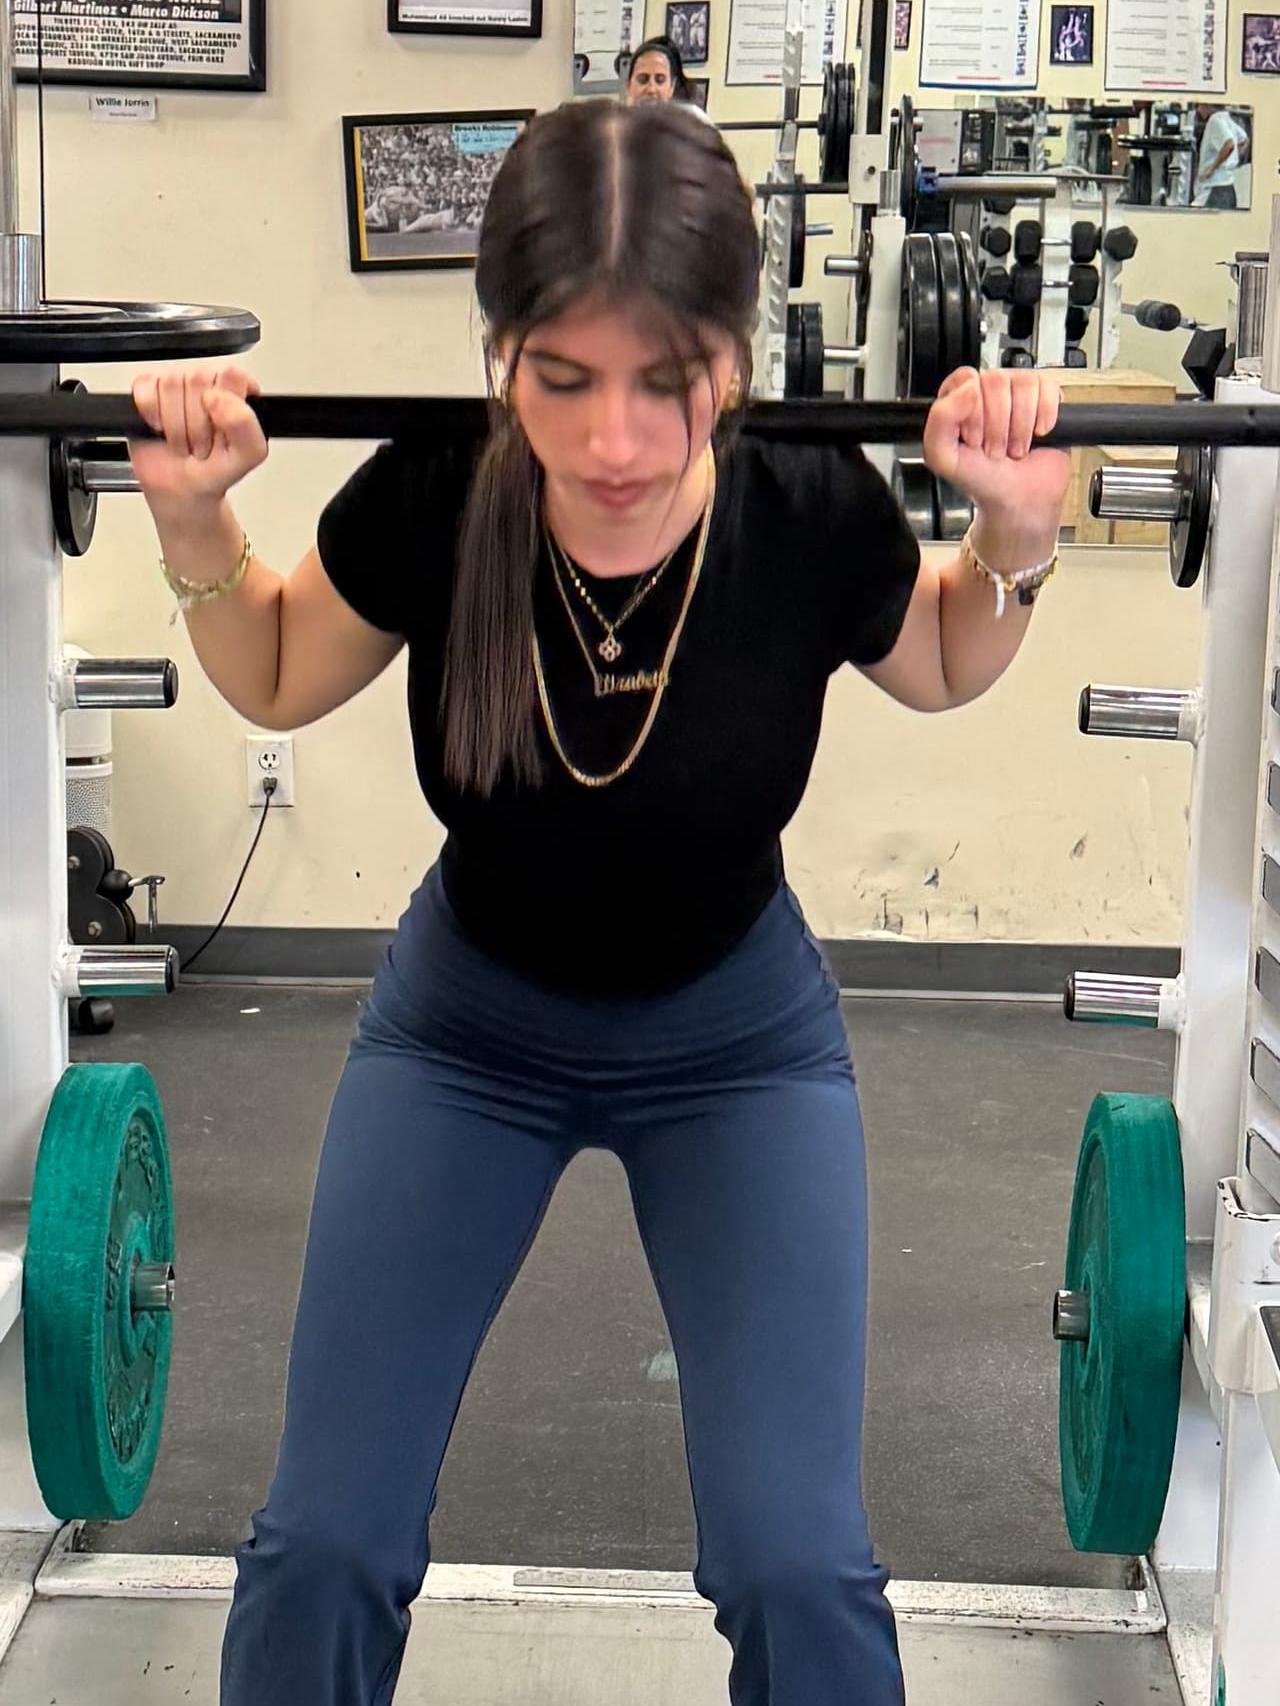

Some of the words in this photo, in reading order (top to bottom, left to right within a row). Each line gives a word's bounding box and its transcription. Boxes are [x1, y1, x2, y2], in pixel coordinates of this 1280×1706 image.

[60, 2, 117, 16] Martinez
[130, 4, 168, 17] Marco
[172, 6, 219, 20] Dickson
[195, 31, 242, 40] SACRAMENTO
[179, 47, 225, 55] SACRAMENTO
[96, 97, 122, 107] Willie
[124, 98, 150, 107] Jorrin
